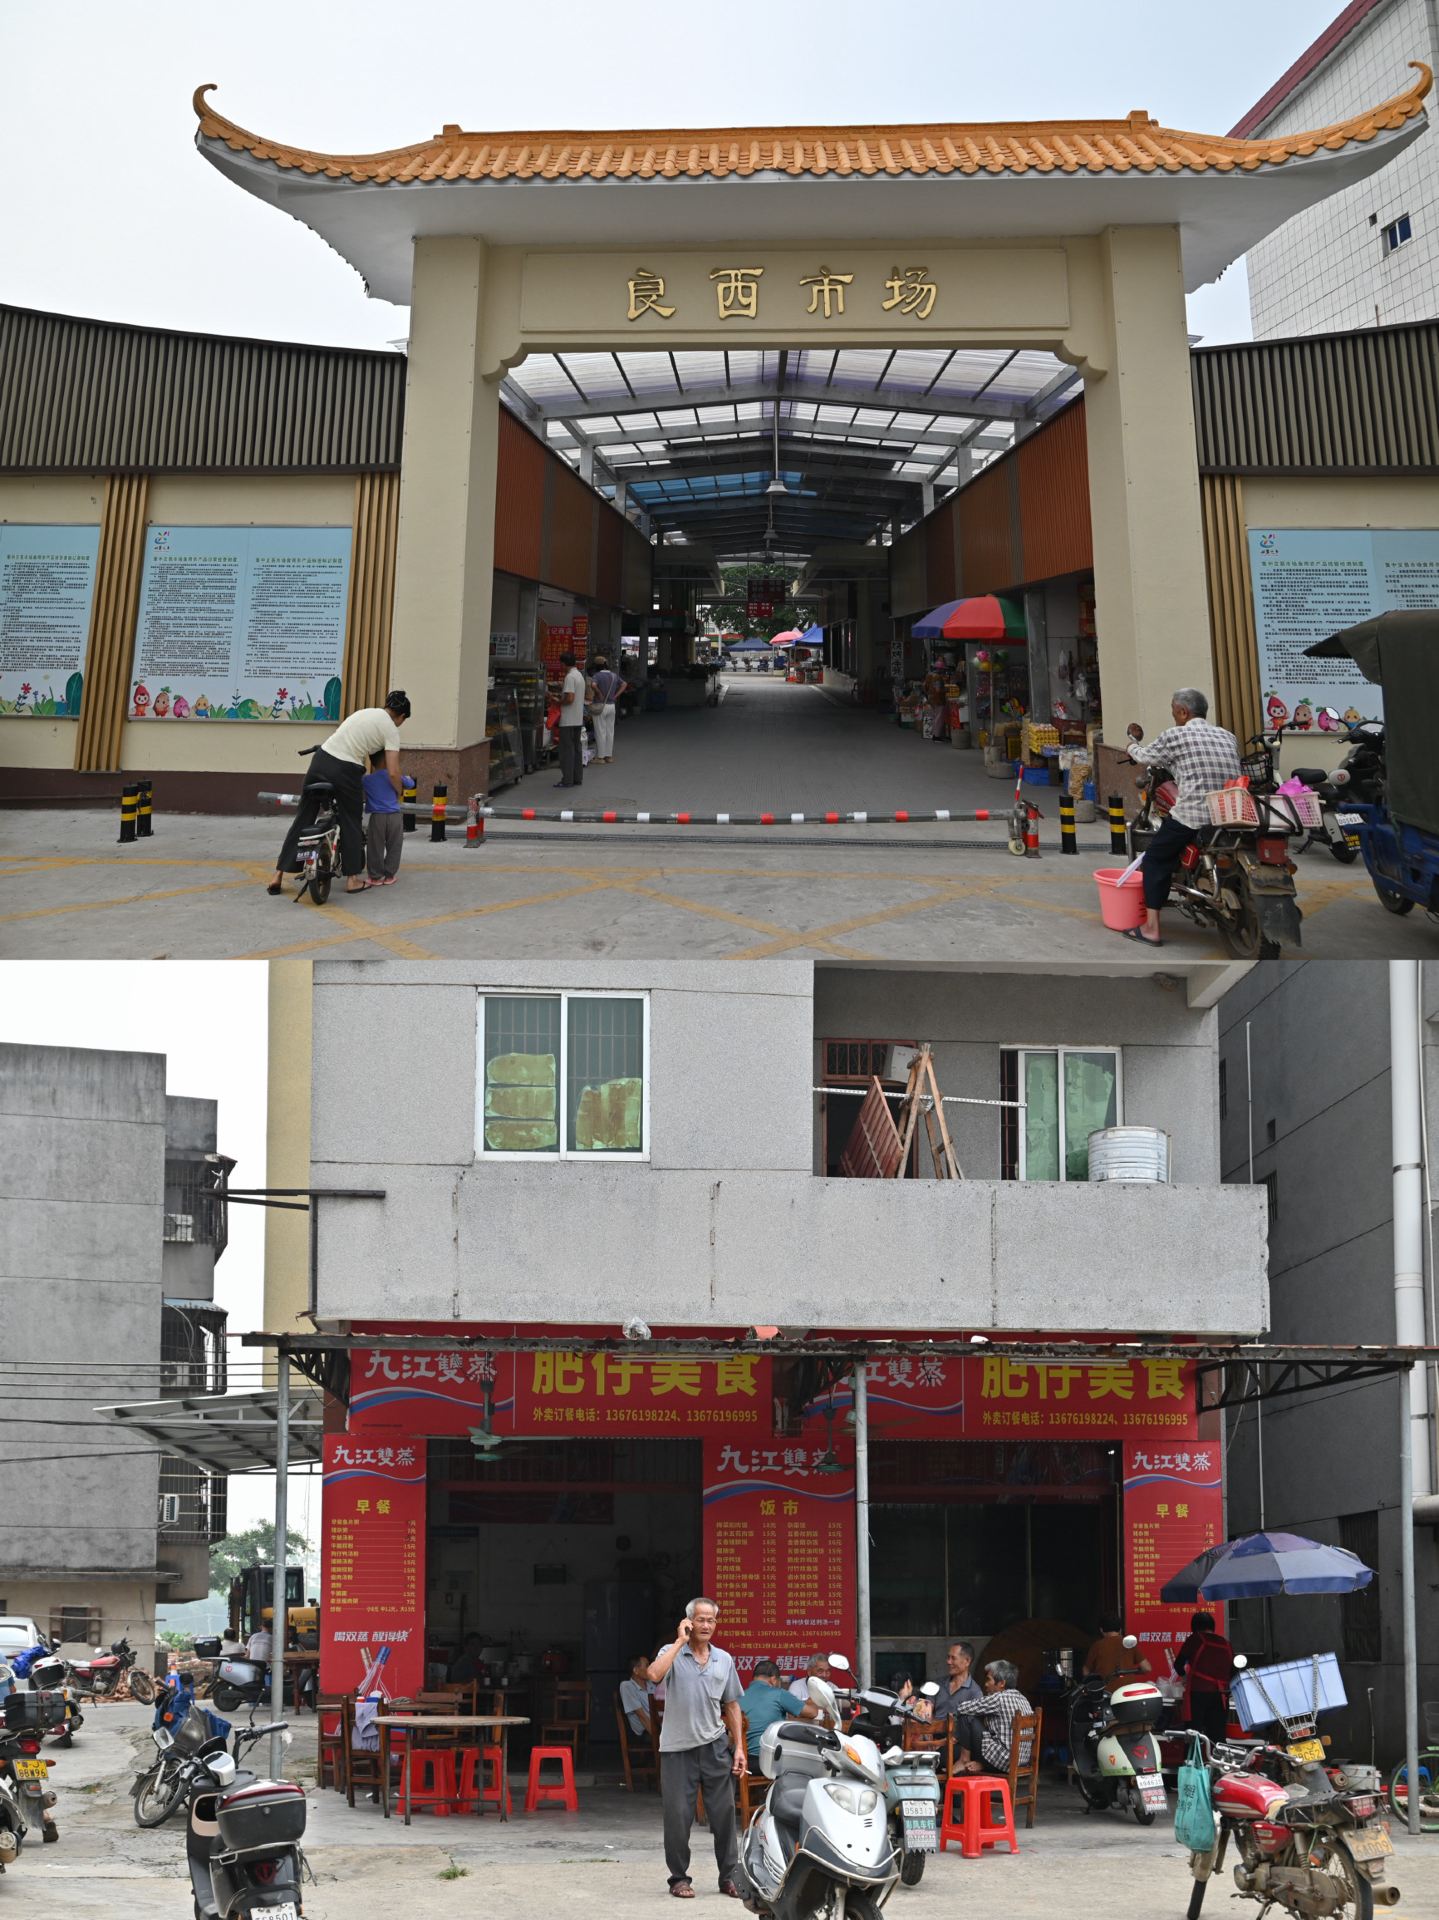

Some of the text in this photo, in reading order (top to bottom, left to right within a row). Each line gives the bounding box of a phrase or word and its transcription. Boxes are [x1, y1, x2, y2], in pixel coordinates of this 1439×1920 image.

[626, 265, 937, 321] 良西市场
[531, 1351, 762, 1397] 肥仔美食
[980, 1357, 1188, 1400] 肥仔美食
[332, 1445, 416, 1467] 九江雙蒸
[1132, 1451, 1212, 1472] 九江雙蒸
[356, 1499, 391, 1515] 早餐
[759, 1499, 799, 1516] 饭市
[1156, 1503, 1189, 1518] 早餐
